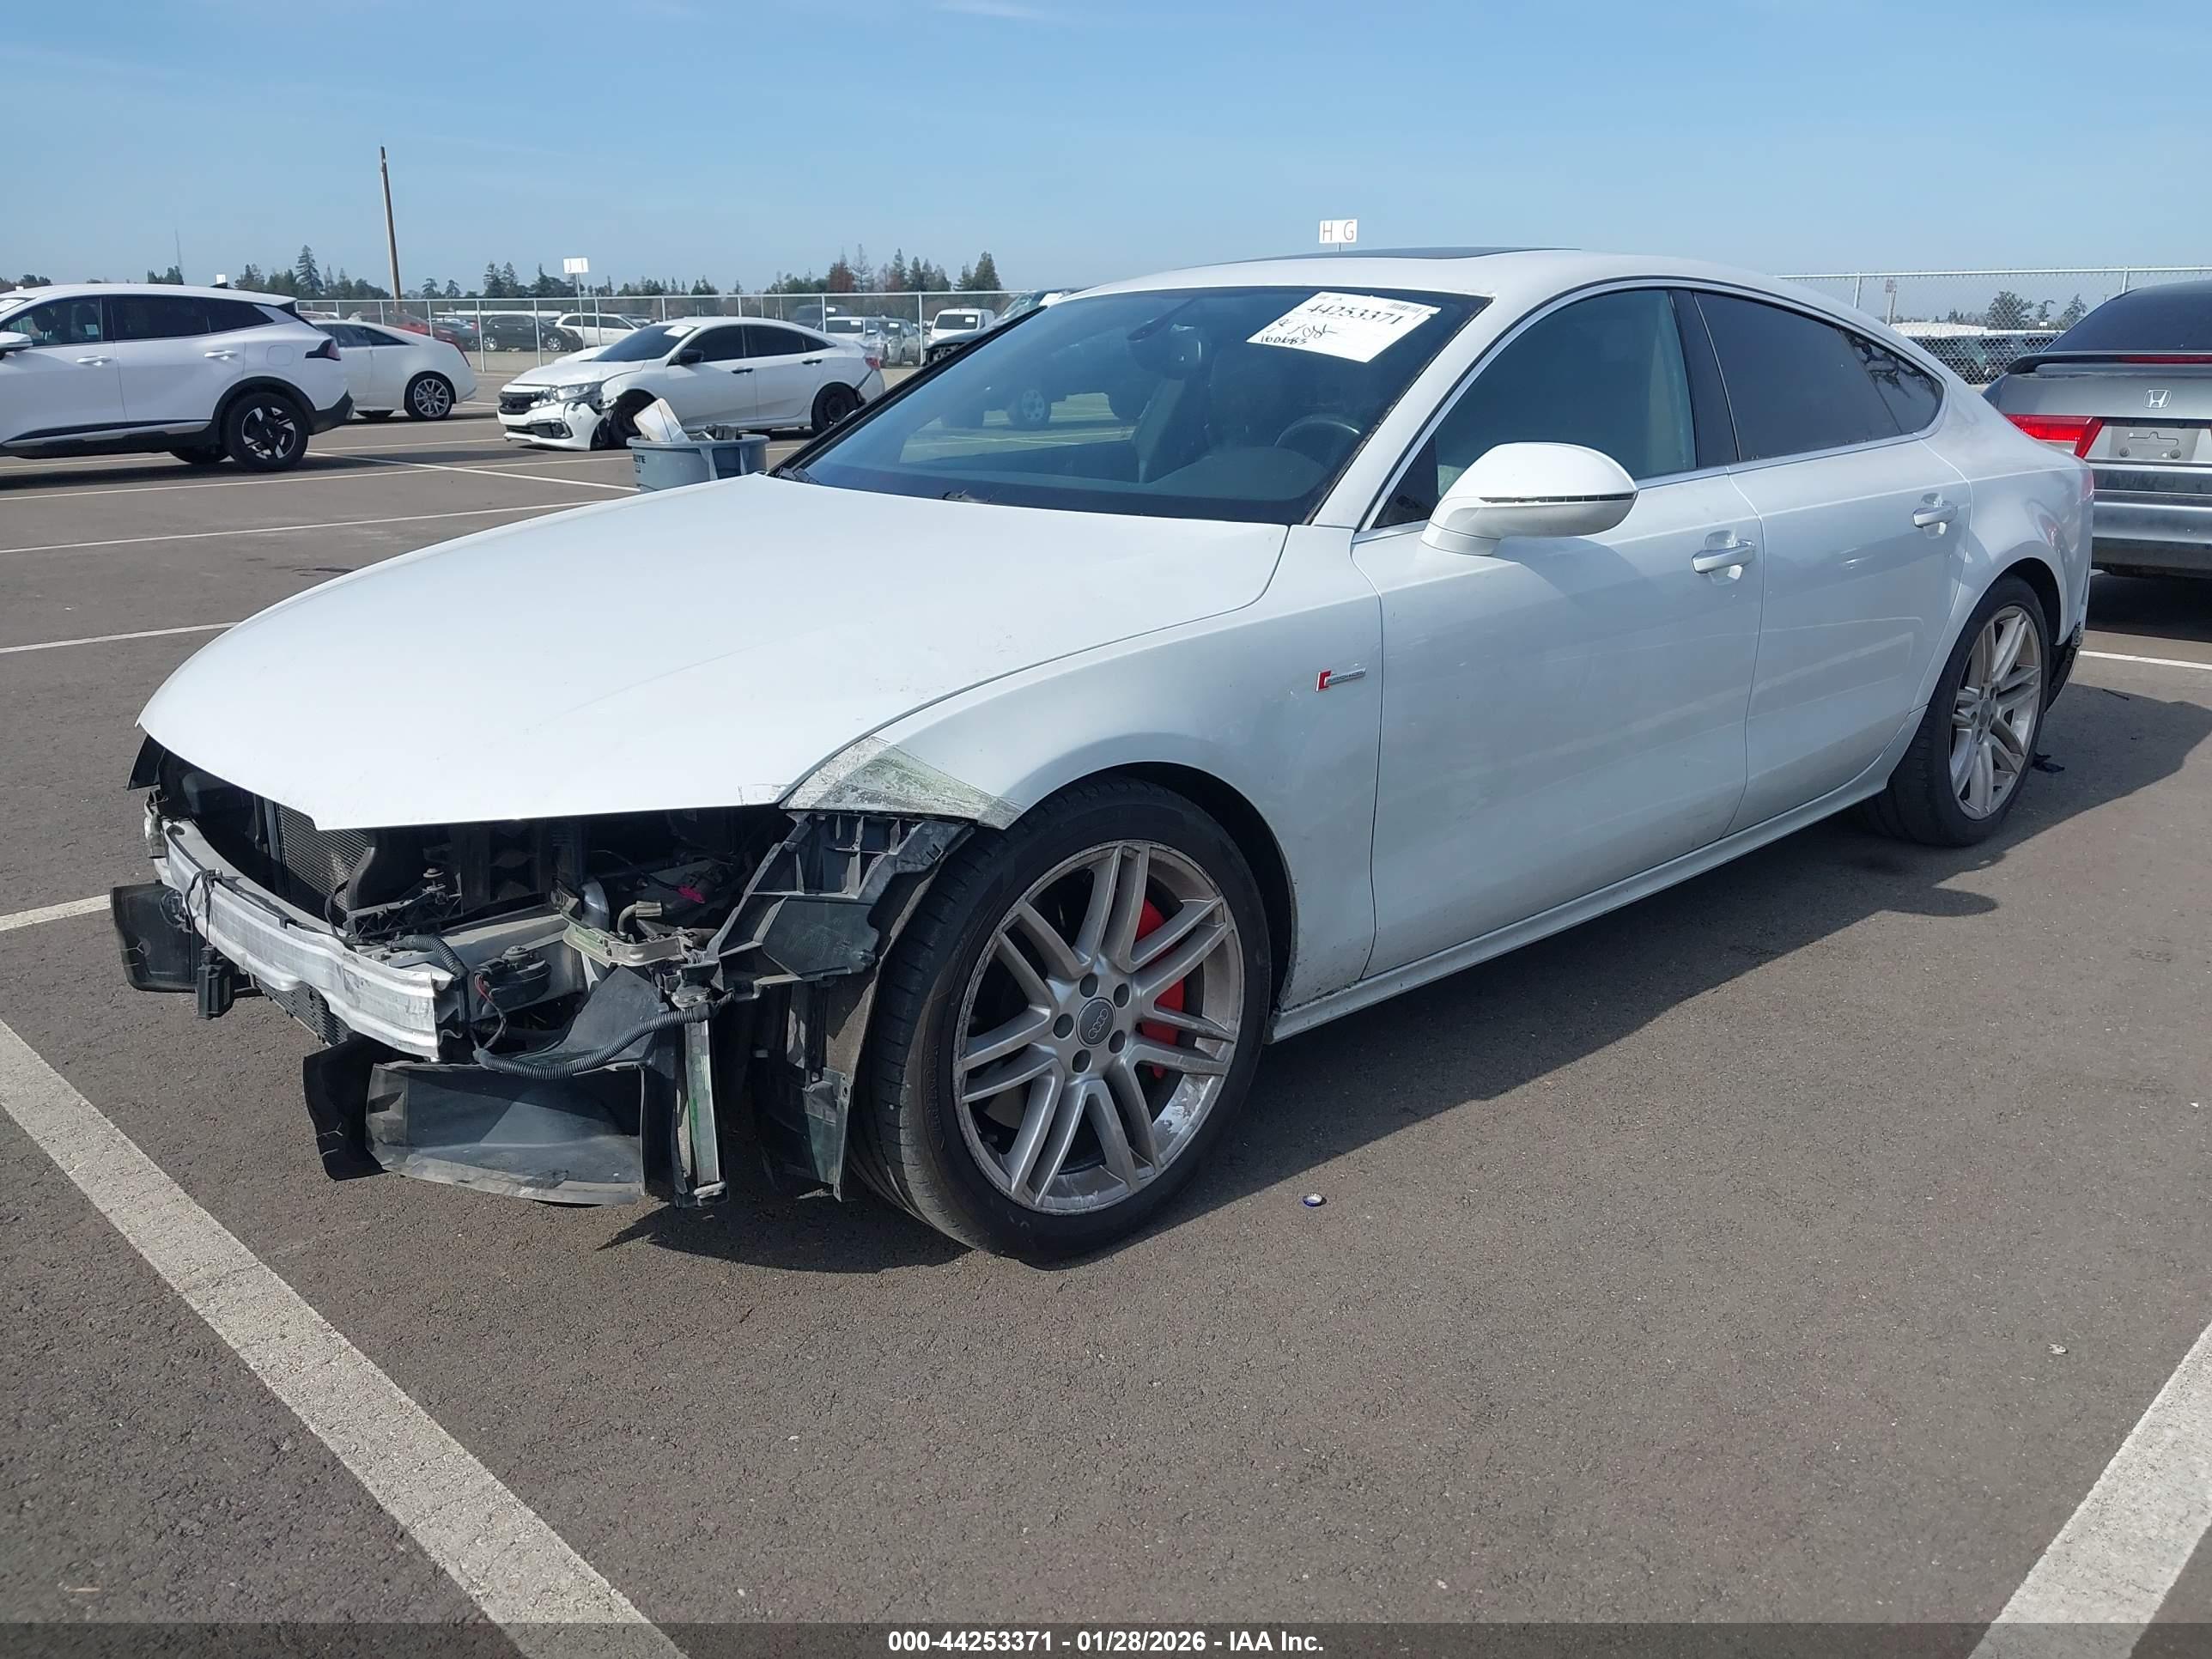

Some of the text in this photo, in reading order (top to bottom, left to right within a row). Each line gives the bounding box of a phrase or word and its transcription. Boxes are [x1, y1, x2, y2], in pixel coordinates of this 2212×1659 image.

[1322, 221, 1354, 241] H G
[1307, 303, 1405, 325] 44253371
